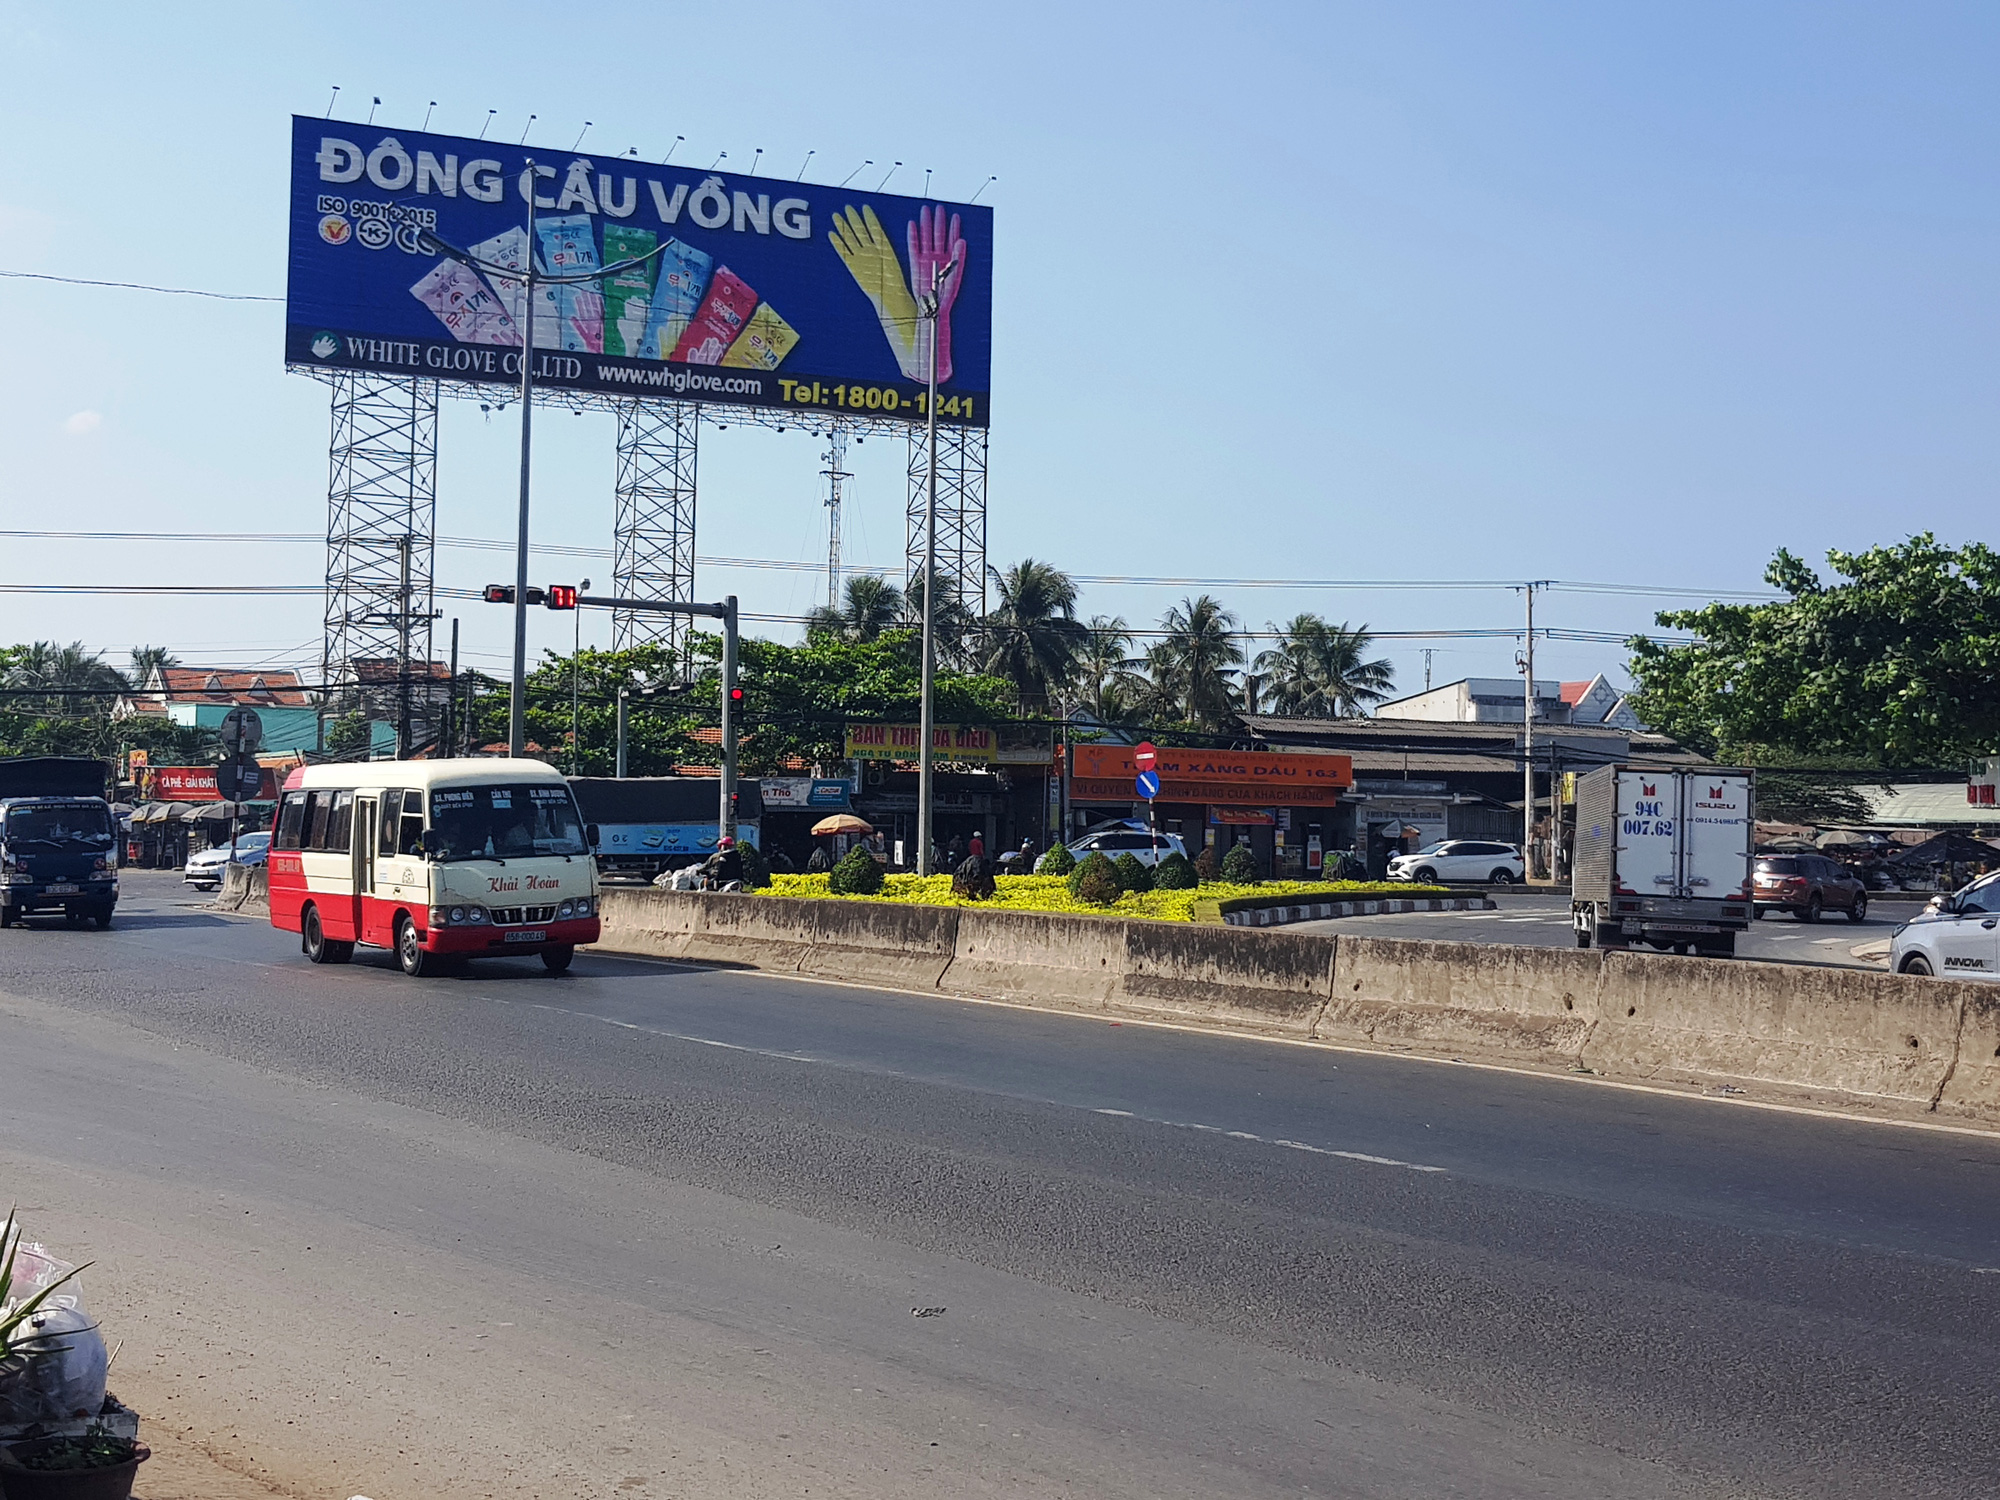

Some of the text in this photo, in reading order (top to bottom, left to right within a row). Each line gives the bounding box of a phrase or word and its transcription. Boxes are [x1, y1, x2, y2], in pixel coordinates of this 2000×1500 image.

[315, 137, 811, 239] ĐÔNG CẦU VỒNG
[318, 196, 345, 213] ISO
[347, 337, 420, 366] WHITE
[427, 345, 497, 373] GLOVE
[598, 364, 762, 395] www.whglove.com
[552, 587, 574, 606] 71
[1306, 769, 1337, 778] 163
[1635, 801, 1663, 818] 94C
[1695, 802, 1736, 810] ISUZU
[1624, 819, 1673, 836] 007.62
[1944, 957, 1983, 968] INNOVA
